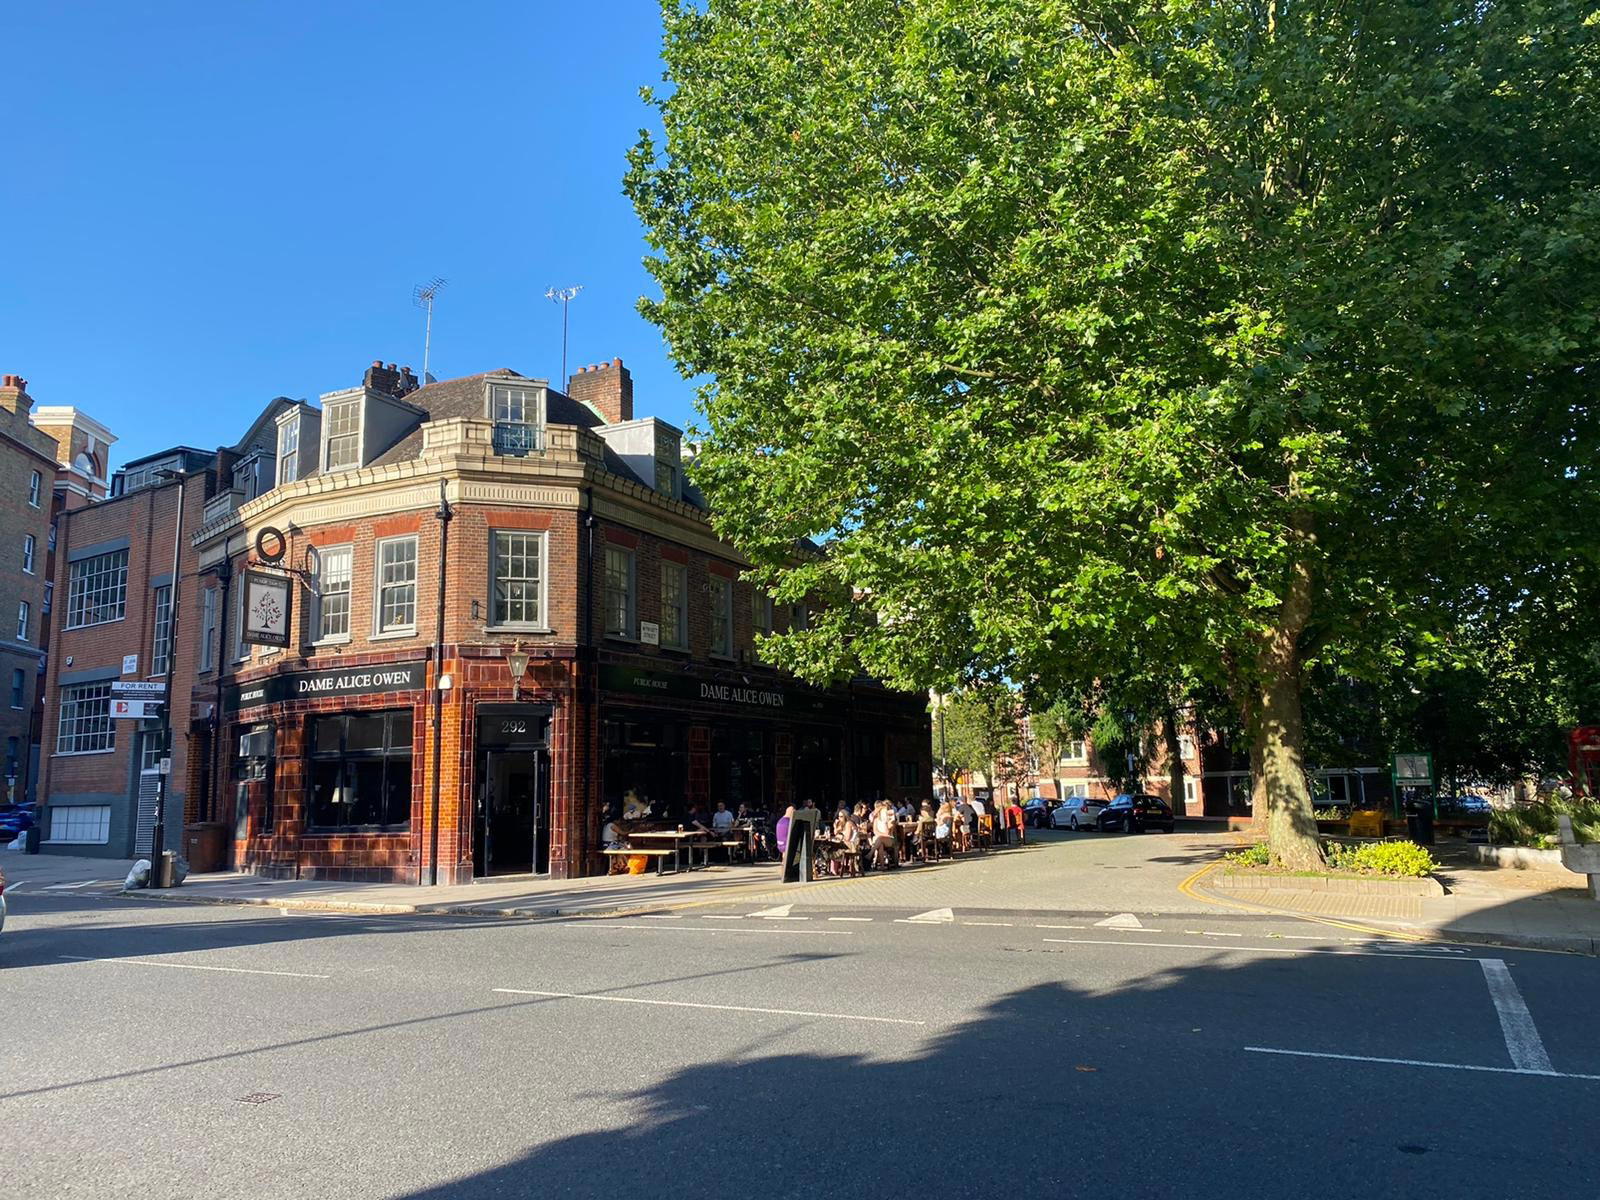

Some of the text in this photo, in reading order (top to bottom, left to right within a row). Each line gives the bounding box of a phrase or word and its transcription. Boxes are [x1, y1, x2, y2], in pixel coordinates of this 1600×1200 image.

[299, 671, 411, 693] DAME ALICE OWEN
[633, 677, 668, 689] PUBLIC HOUSE
[700, 683, 784, 707] DAME ALICE OWEN
[501, 720, 526, 733] 292
